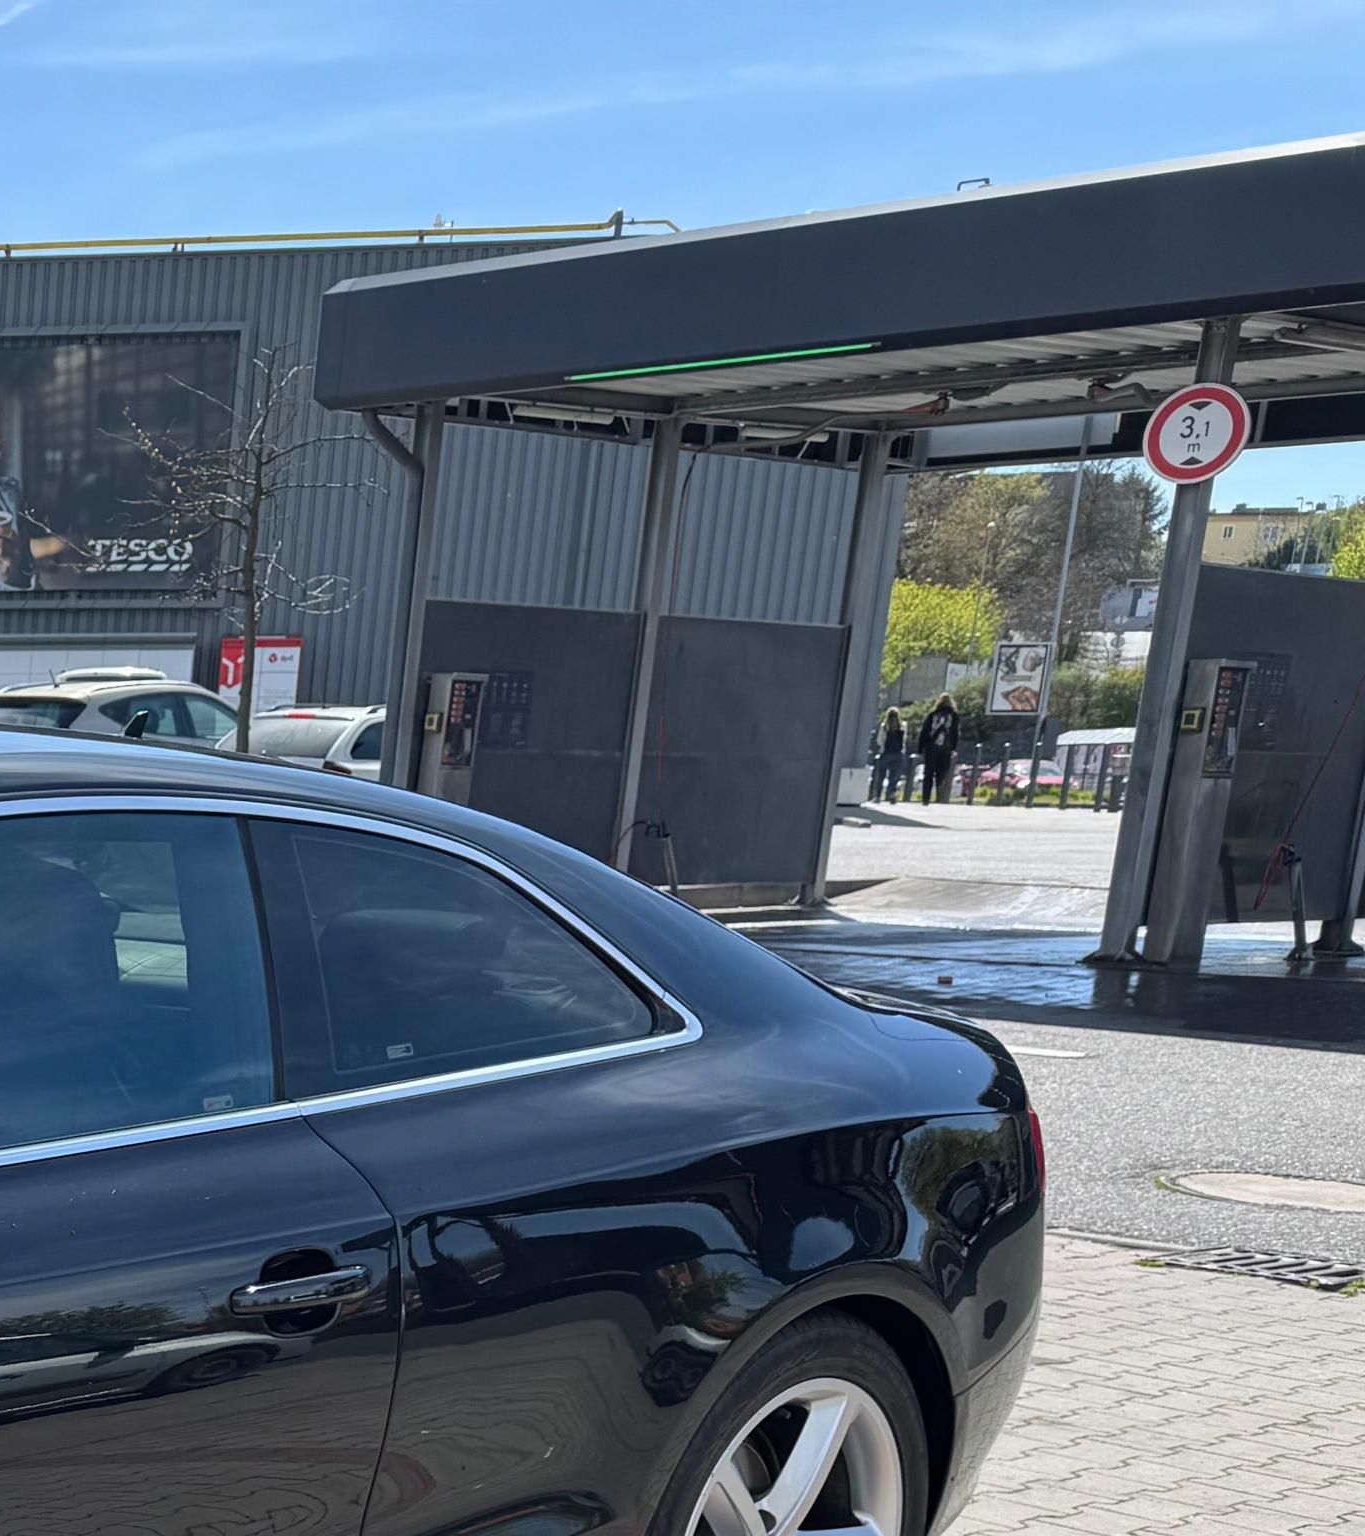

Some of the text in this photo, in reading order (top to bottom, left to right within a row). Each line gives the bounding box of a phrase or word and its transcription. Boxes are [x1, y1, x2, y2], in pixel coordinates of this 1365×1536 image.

[1179, 415, 1210, 440] 3,1
[1187, 442, 1201, 453] m
[87, 538, 194, 561] TESCO
